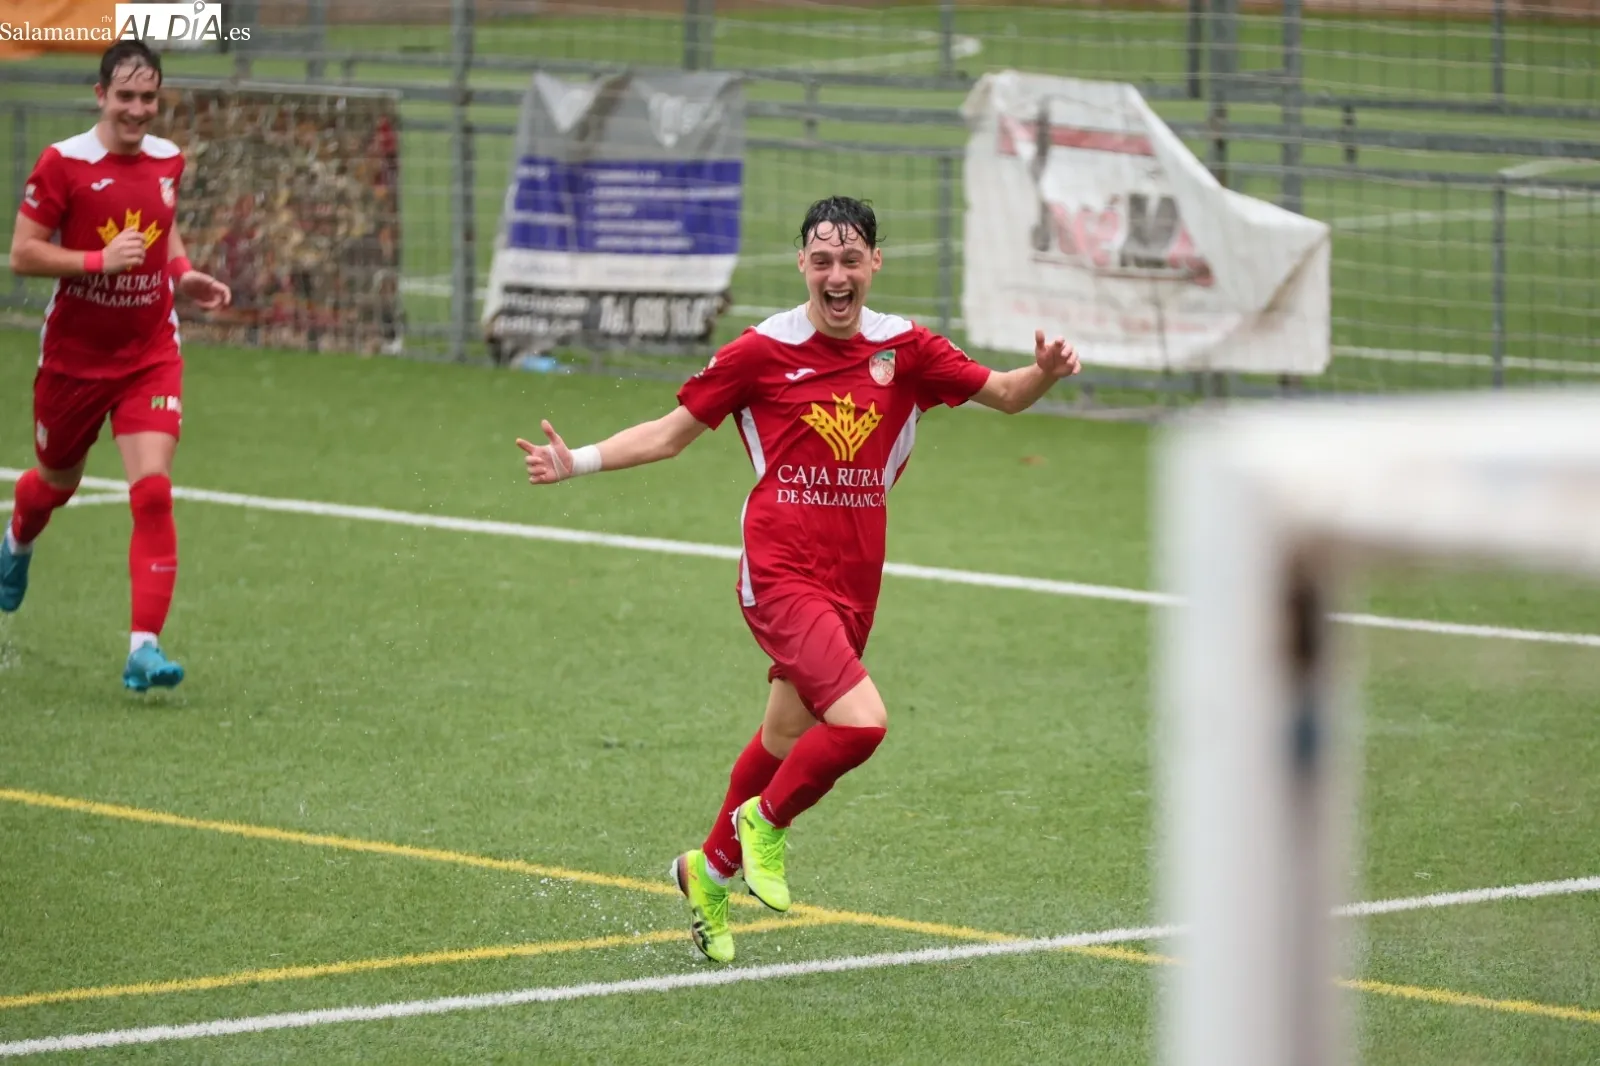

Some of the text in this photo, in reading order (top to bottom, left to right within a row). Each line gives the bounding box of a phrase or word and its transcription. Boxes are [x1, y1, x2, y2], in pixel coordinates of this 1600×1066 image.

[777, 464, 831, 489] CAJA
[776, 489, 885, 508] DE SALAMANCA
